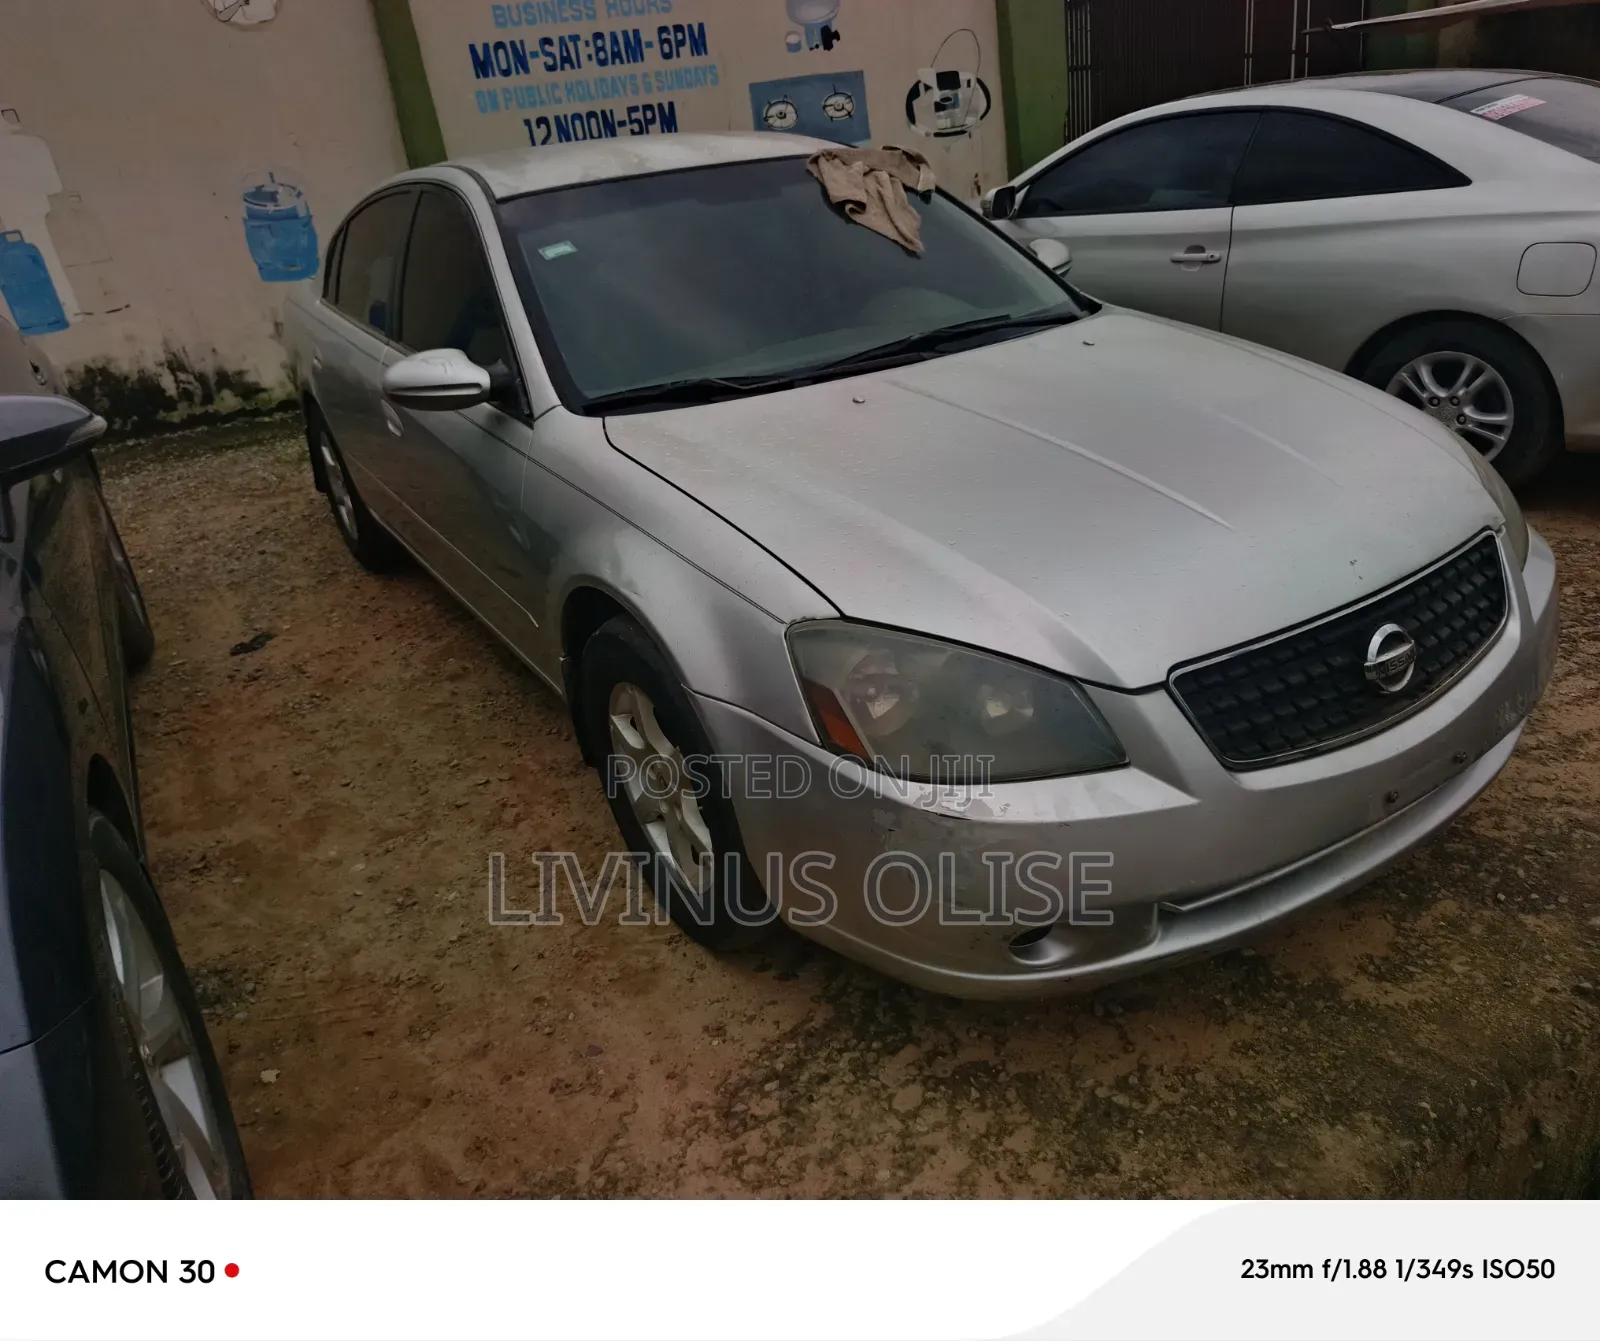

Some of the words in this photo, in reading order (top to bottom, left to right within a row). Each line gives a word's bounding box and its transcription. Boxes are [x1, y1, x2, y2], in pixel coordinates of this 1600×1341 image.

[491, 0, 597, 29] BUSINESS
[475, 87, 499, 115] ON
[502, 81, 563, 111] PUBLIC
[564, 73, 639, 104] HOLIDAYS
[654, 64, 720, 93] SUNDAYS
